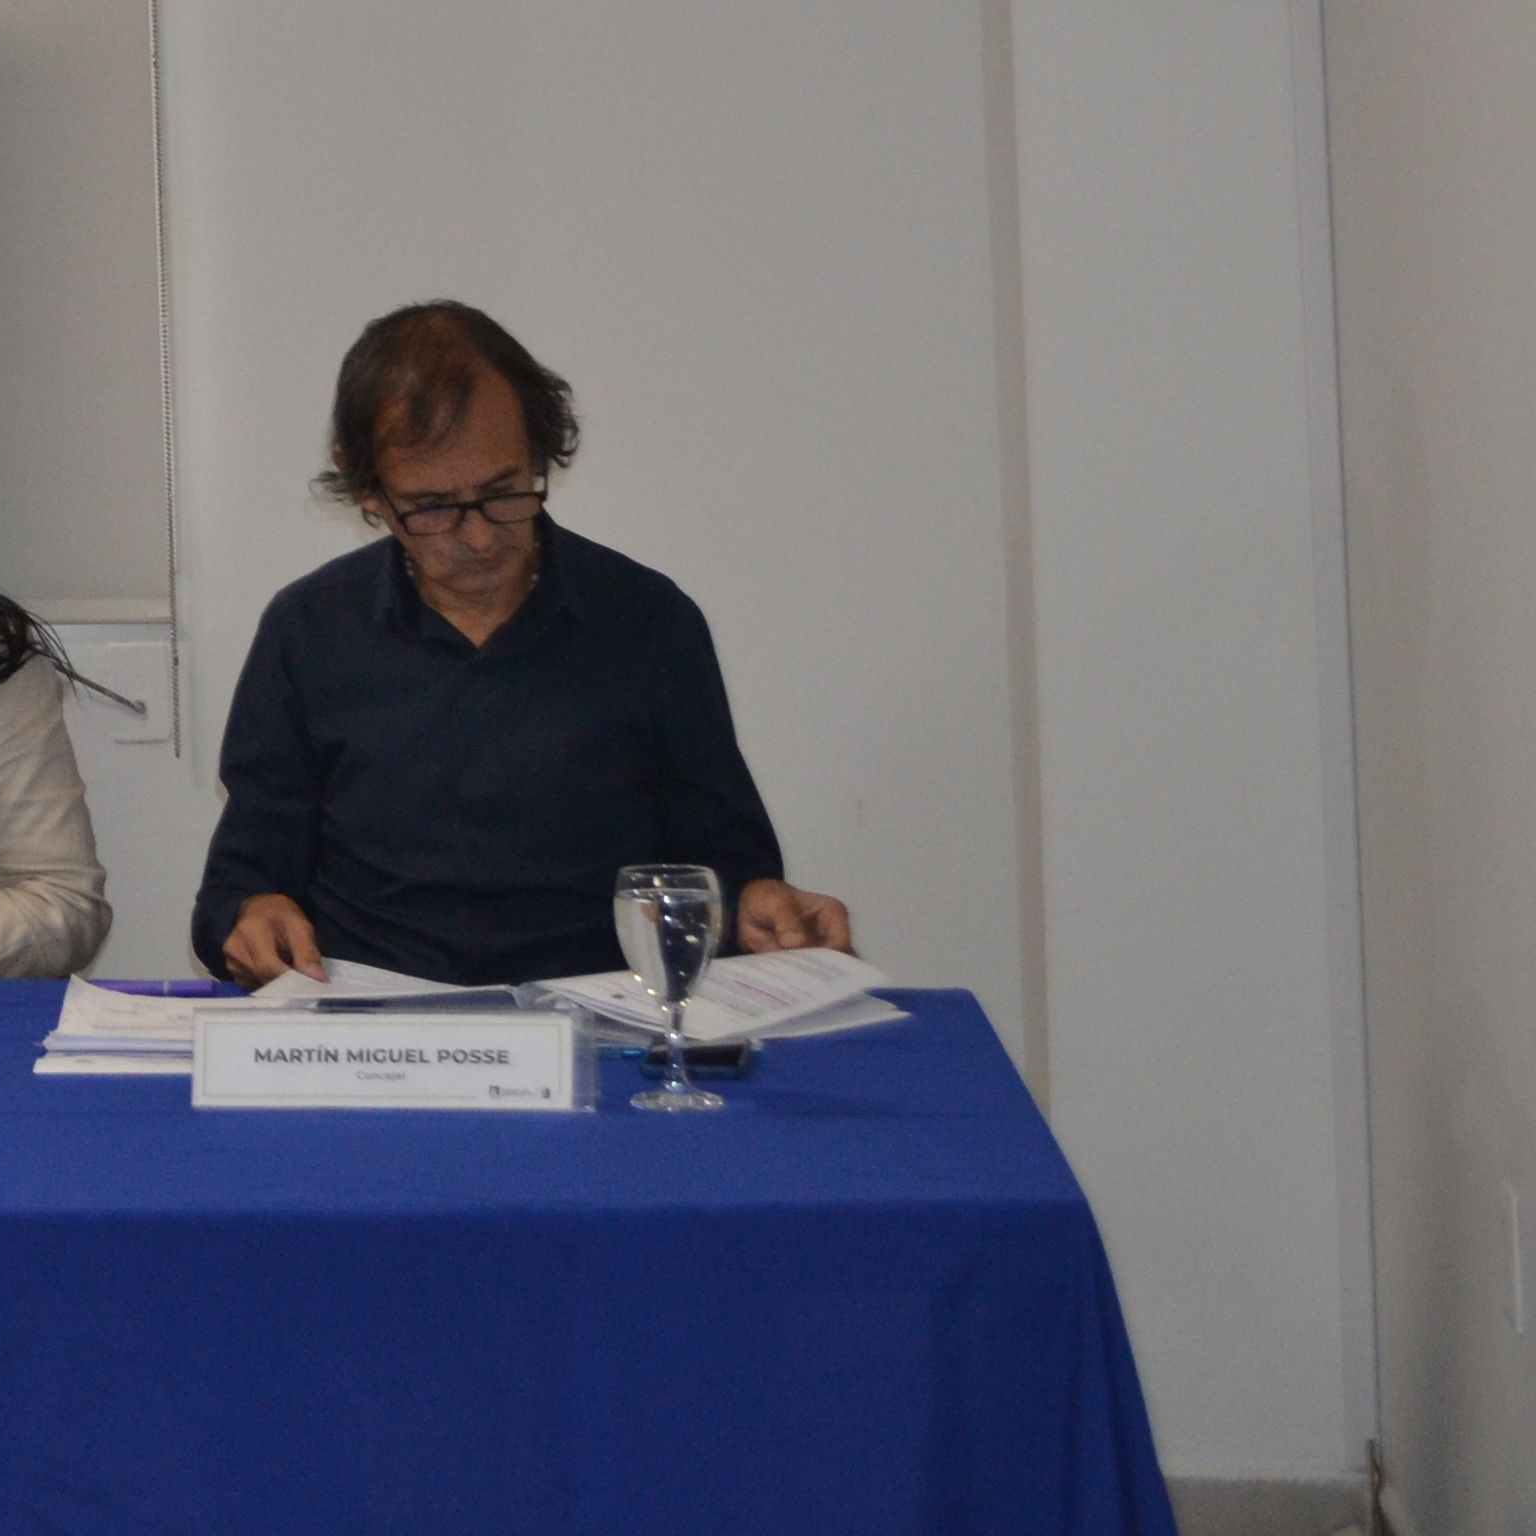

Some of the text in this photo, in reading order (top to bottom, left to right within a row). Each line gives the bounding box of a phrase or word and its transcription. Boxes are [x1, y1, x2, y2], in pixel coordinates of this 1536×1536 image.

[253, 1043, 510, 1064] MARTÍN MIGUEL POSSE
